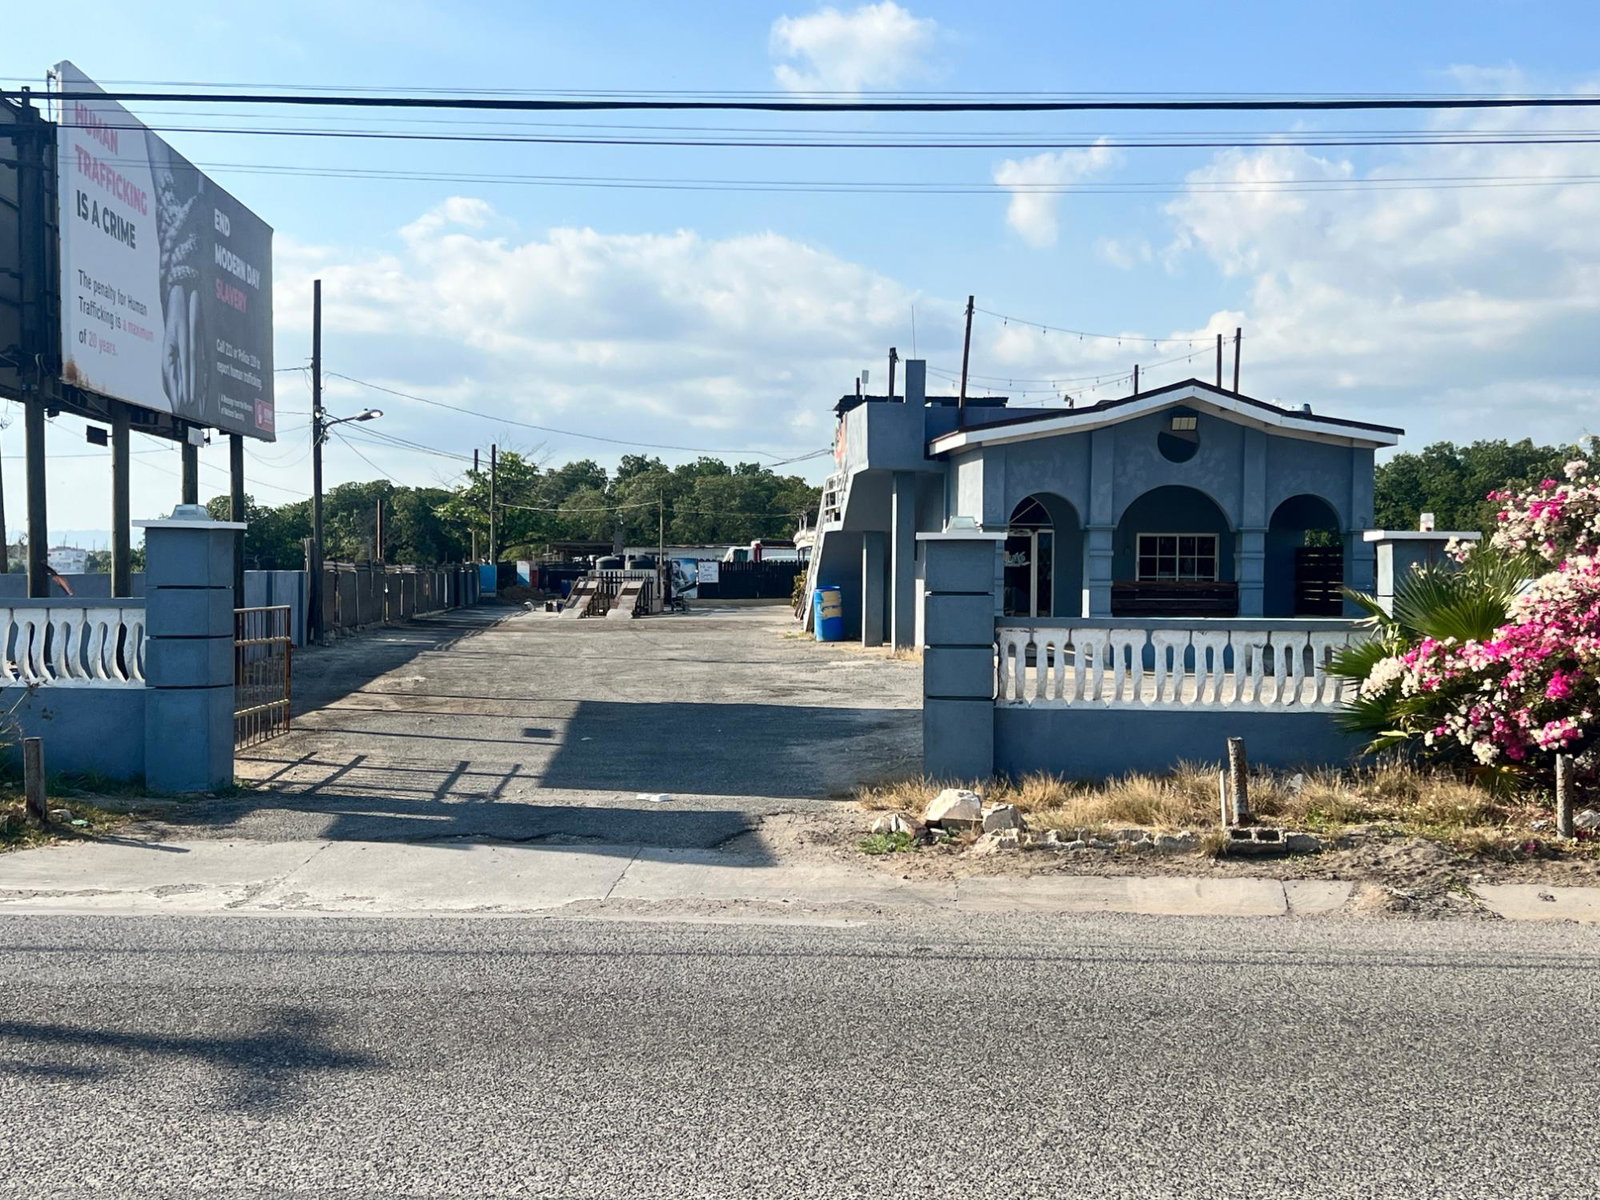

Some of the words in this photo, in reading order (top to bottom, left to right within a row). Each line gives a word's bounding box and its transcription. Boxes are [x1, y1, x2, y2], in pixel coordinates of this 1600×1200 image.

[75, 100, 118, 155] HUMAN
[75, 143, 147, 216] TRAFFICKING
[76, 189, 88, 221] IS
[92, 200, 100, 229] A
[103, 206, 136, 249] CRIME
[214, 207, 230, 237] END
[214, 242, 246, 282] MODERN
[246, 263, 260, 290] DAY
[78, 269, 91, 290] The
[93, 280, 116, 305] penalty
[215, 278, 247, 313] SLAVERY
[78, 295, 114, 329] Trafficking
[79, 328, 87, 344] of
